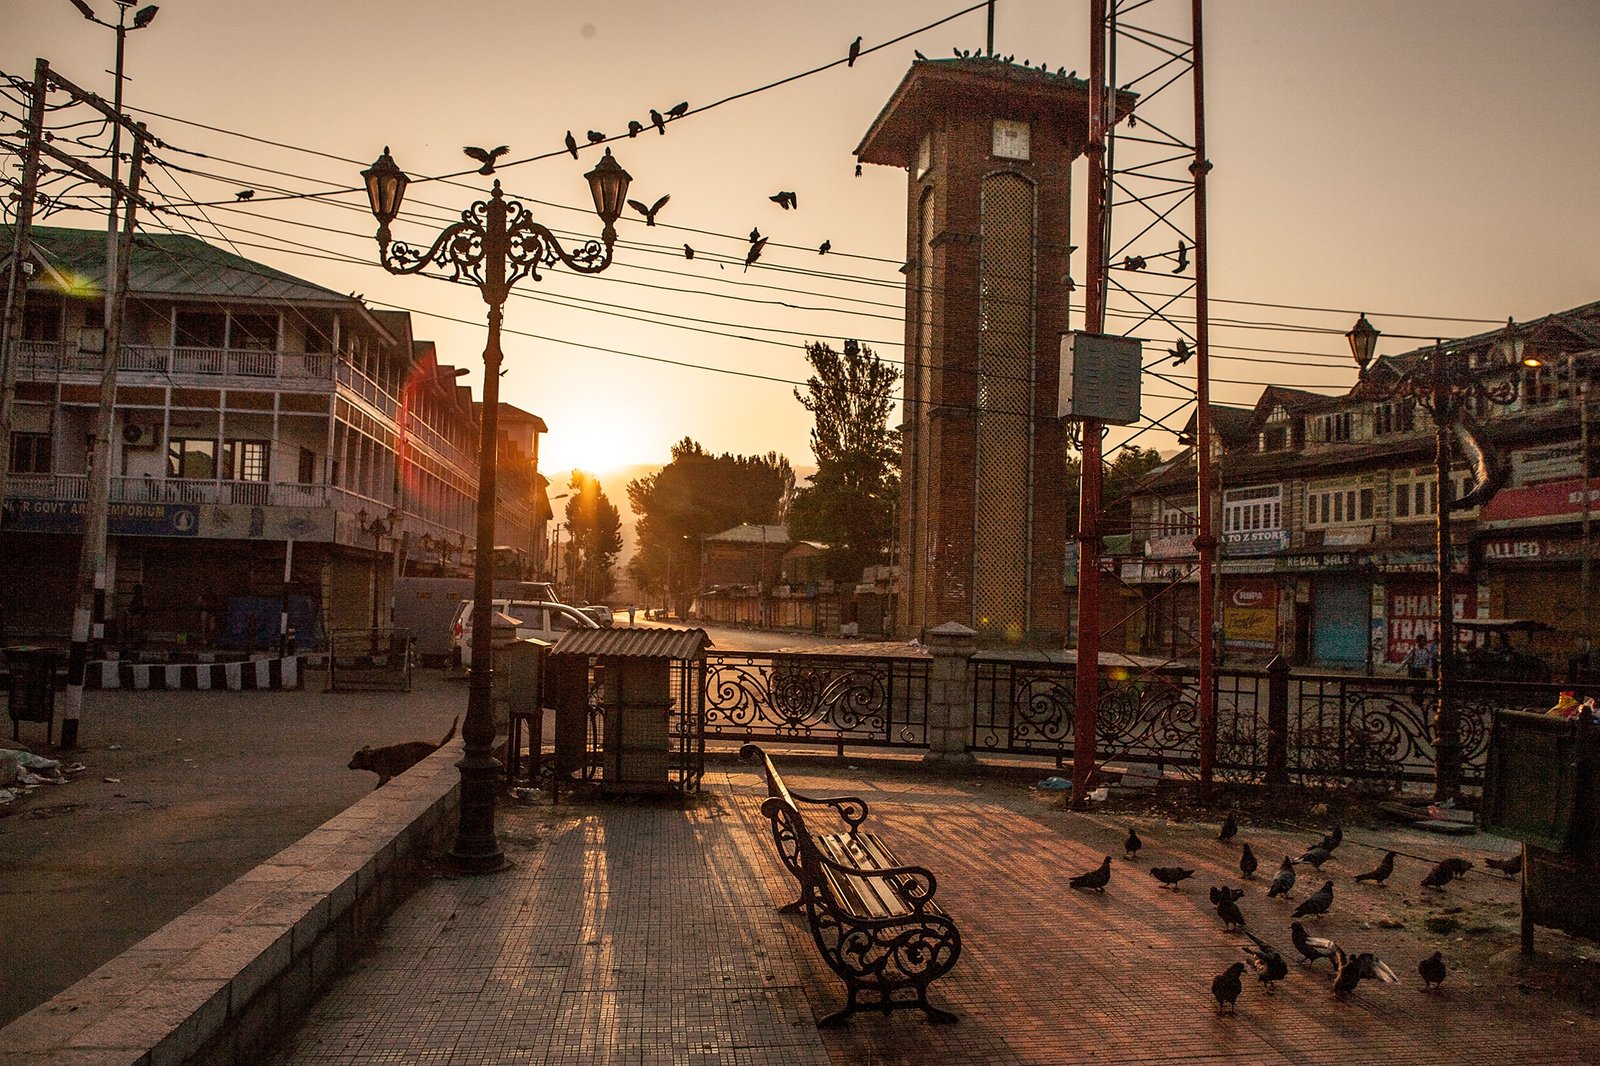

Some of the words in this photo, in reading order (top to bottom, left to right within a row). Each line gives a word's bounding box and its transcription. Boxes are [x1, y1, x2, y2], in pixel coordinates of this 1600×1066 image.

[1228, 534, 1241, 542] TO
[1243, 533, 1250, 541] Z
[1251, 531, 1285, 541] STORE
[1485, 542, 1539, 558] ALLIED
[1287, 556, 1318, 567] REGAL
